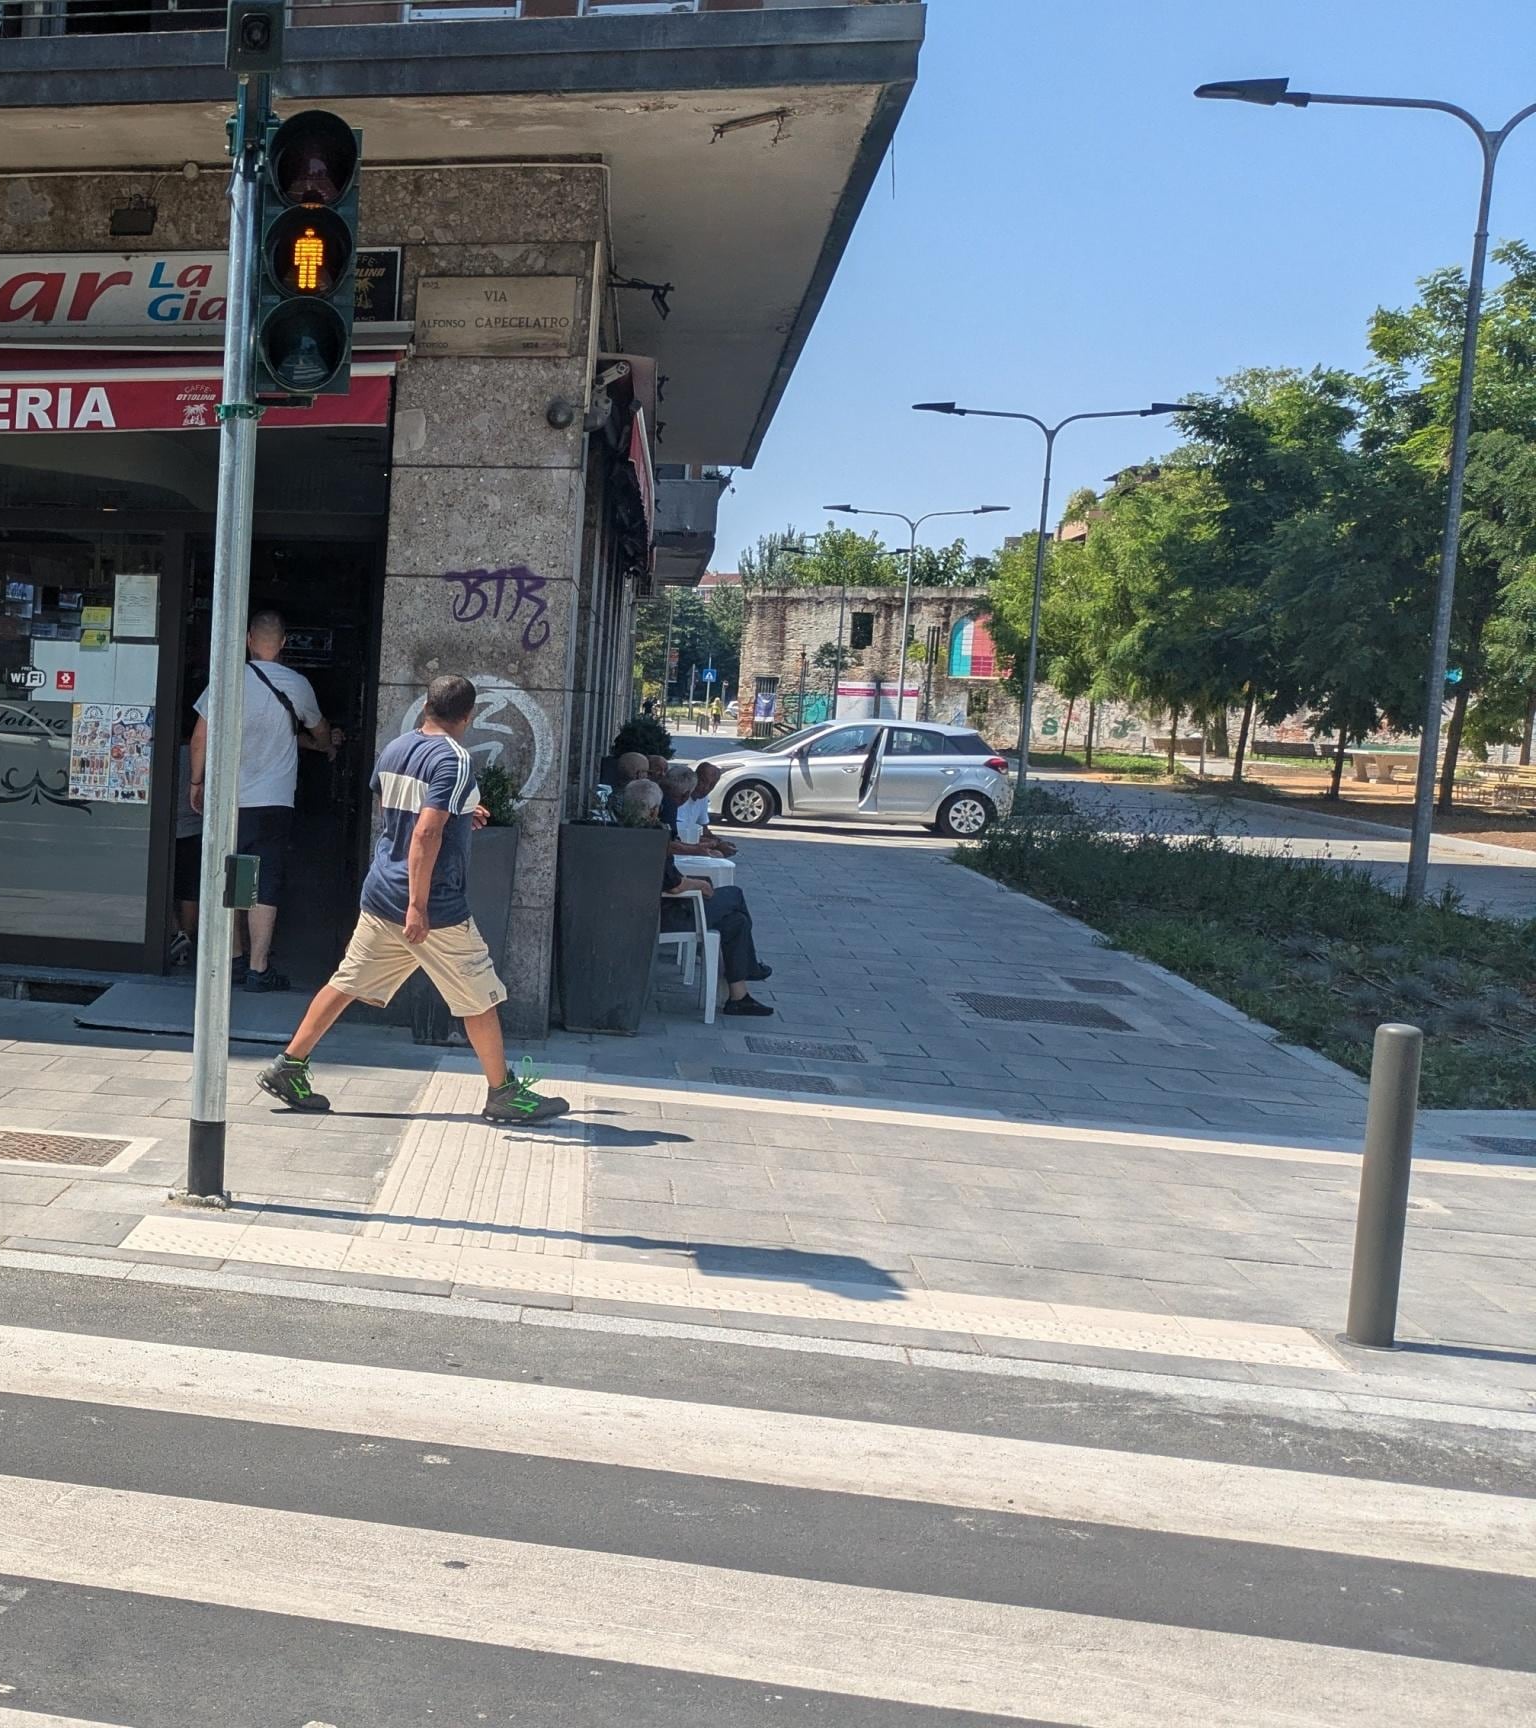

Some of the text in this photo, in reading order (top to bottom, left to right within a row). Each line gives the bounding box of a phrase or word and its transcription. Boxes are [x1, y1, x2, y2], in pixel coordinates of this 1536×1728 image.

[148, 262, 213, 289] La
[483, 290, 508, 302] VIA
[420, 316, 570, 329] ALFONSO CAPECELATRO
